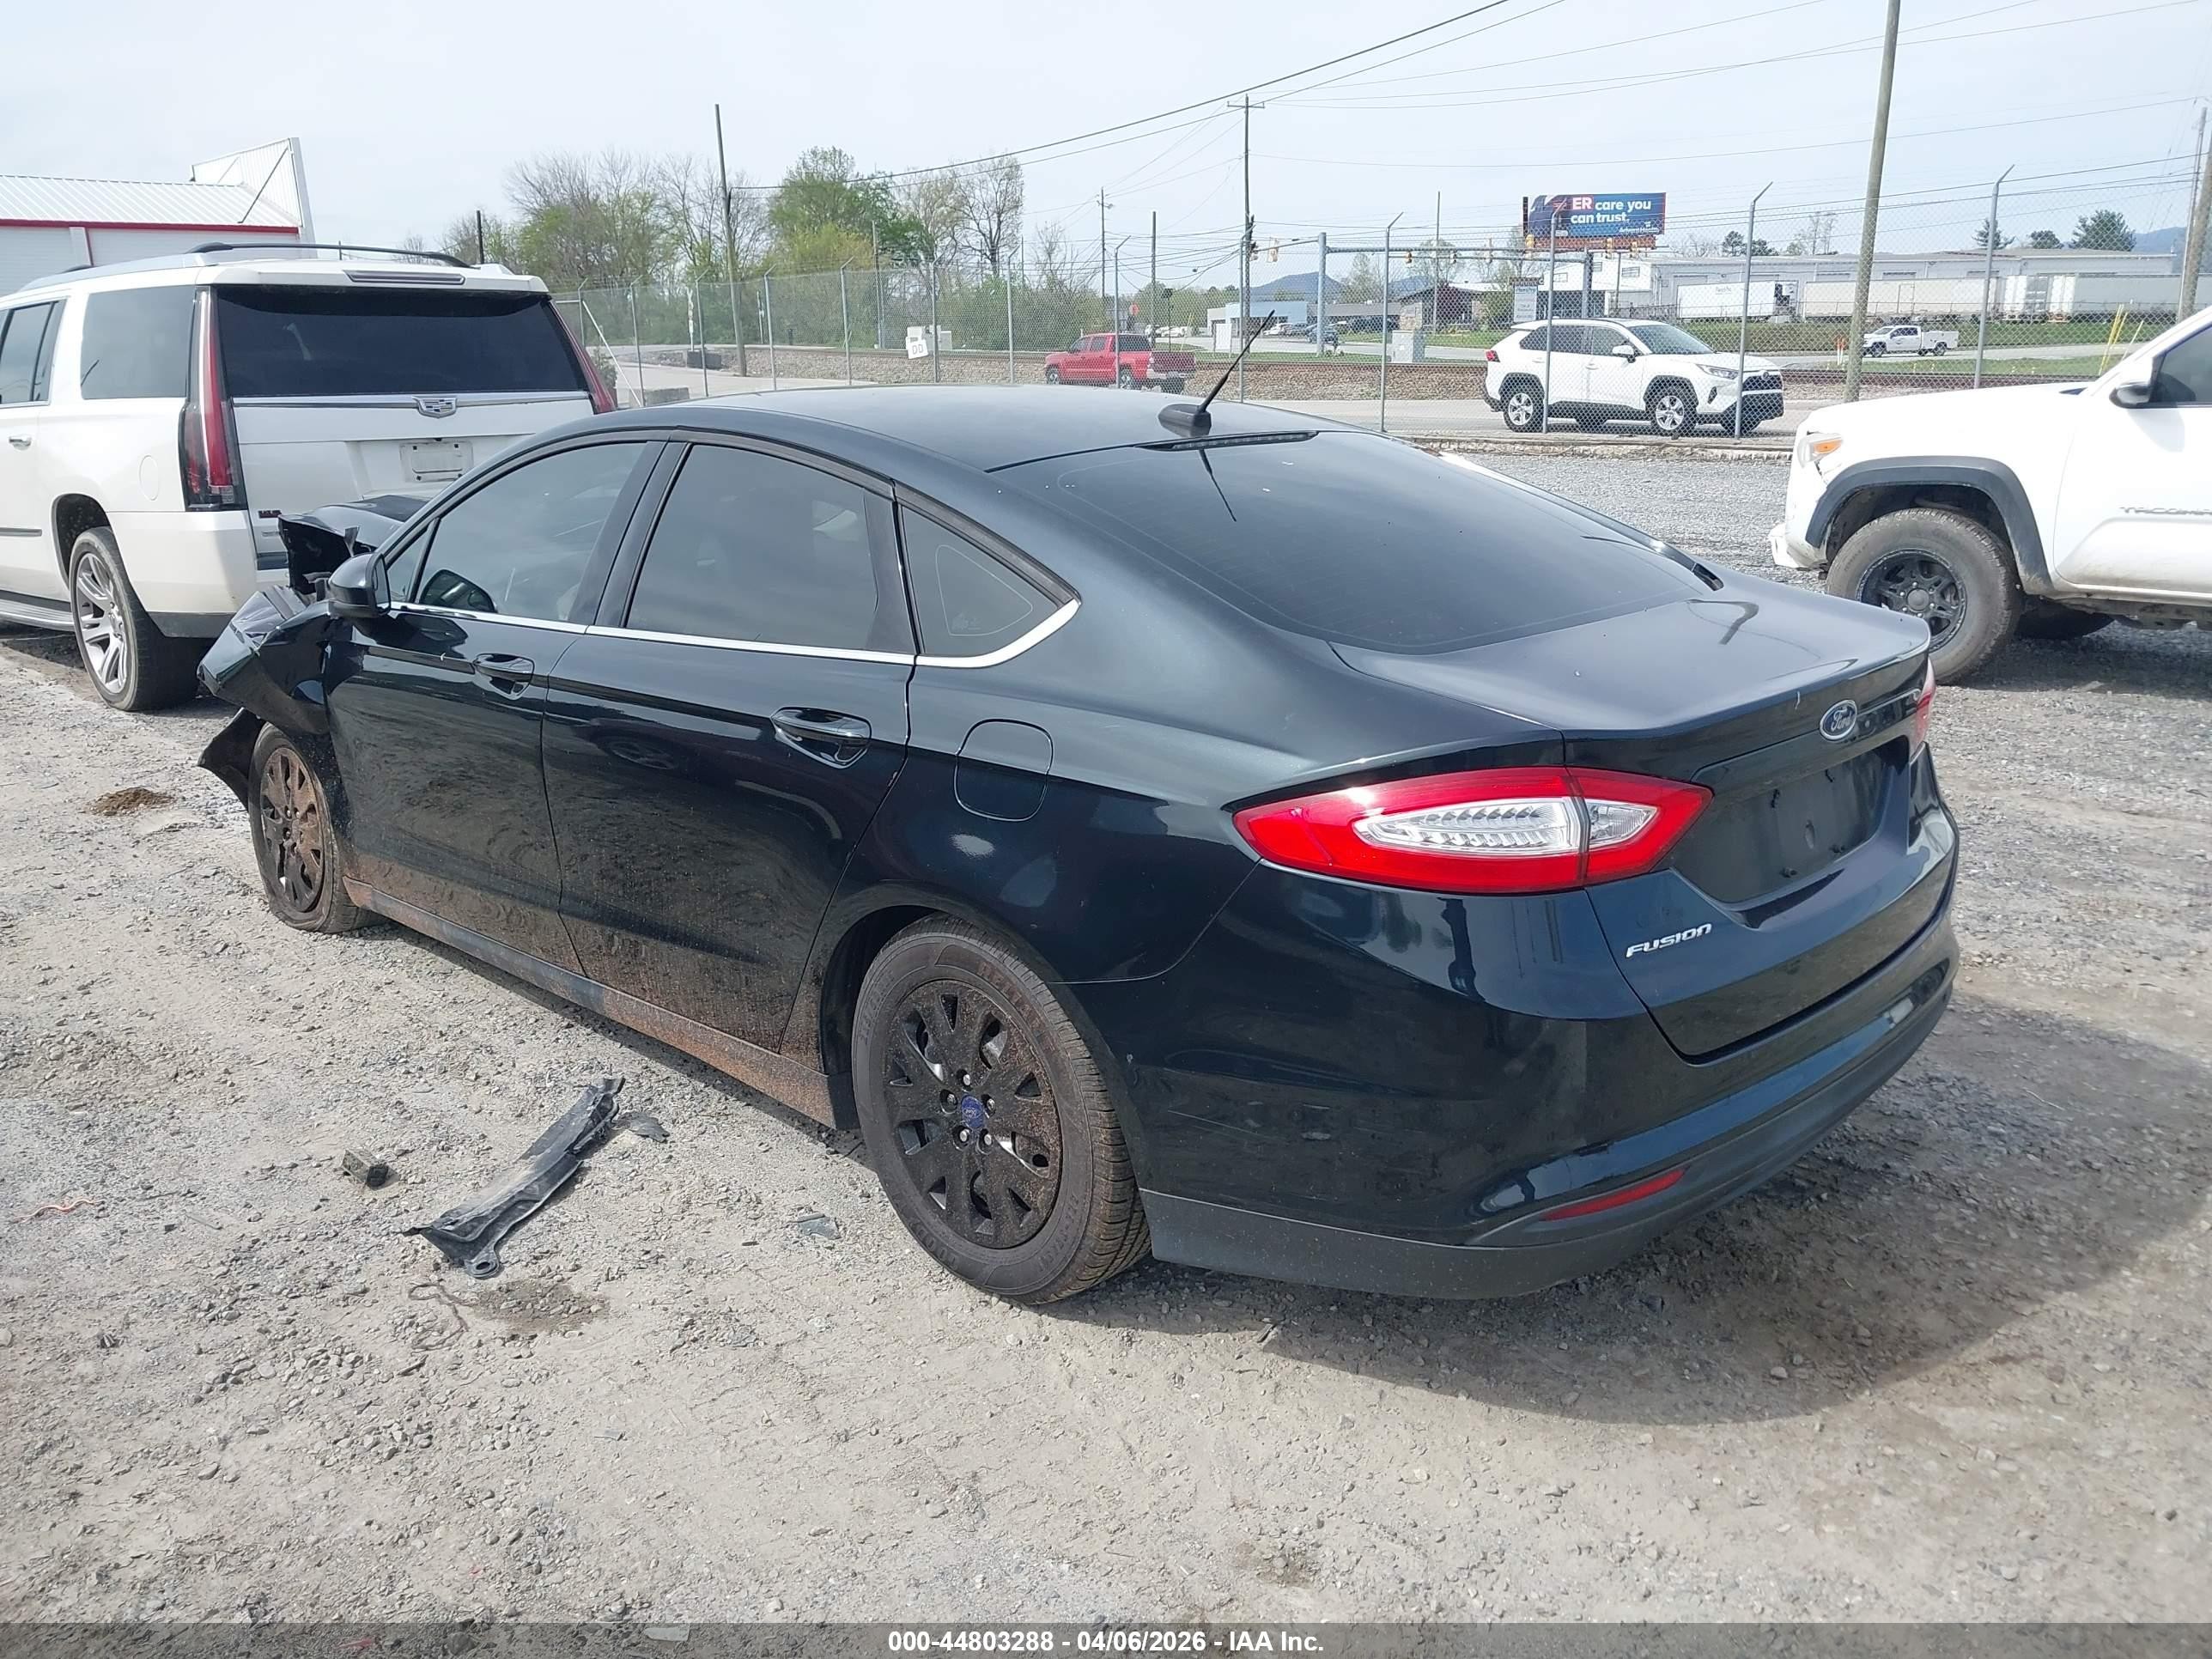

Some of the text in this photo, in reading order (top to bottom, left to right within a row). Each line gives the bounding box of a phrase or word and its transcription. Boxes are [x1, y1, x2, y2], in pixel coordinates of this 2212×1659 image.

[1572, 198, 1651, 215] ER care you
[1571, 212, 1630, 223] can trust.
[1626, 923, 1712, 957] FUSION
